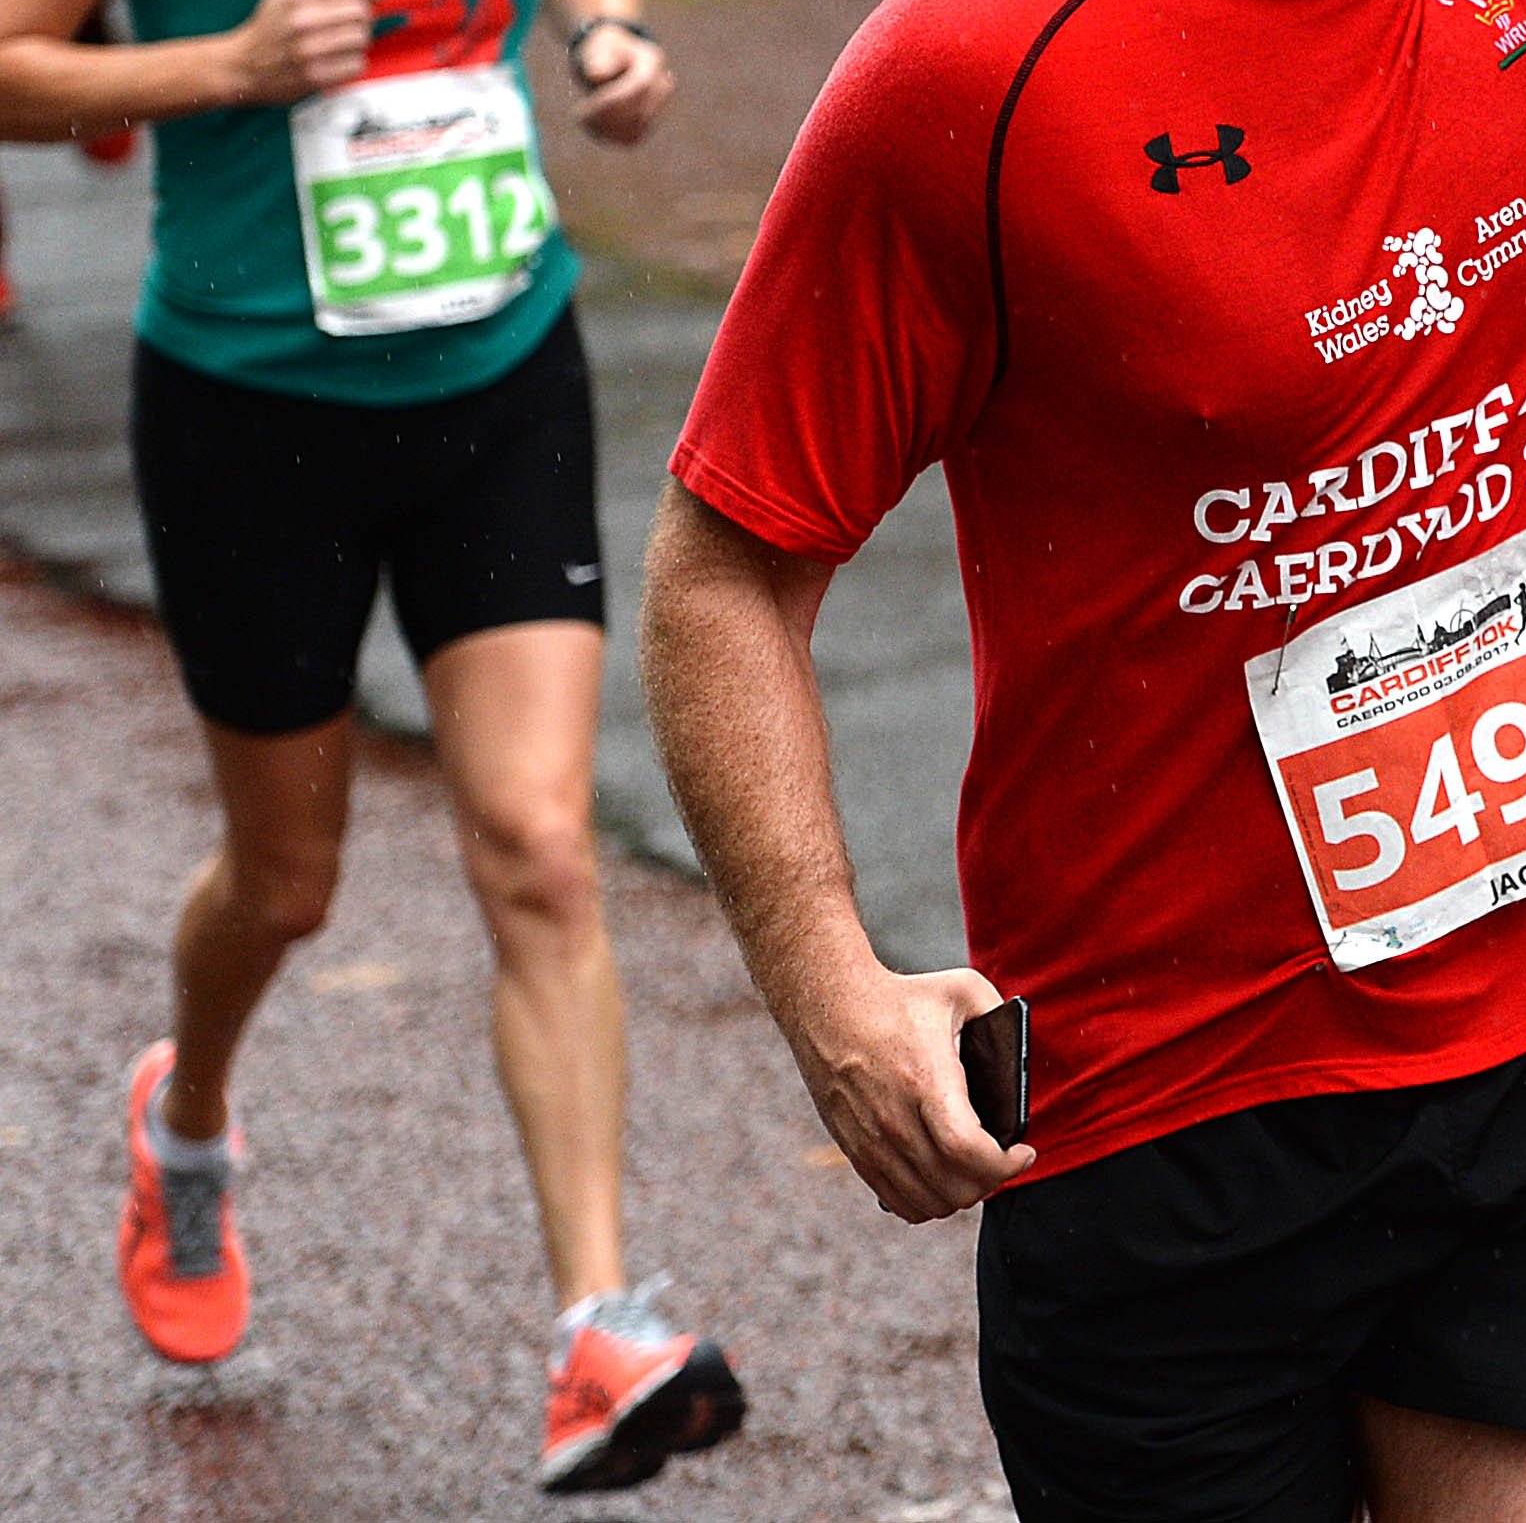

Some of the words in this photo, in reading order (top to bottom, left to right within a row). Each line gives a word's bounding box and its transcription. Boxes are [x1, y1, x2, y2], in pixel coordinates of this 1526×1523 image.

[322, 170, 540, 287] 3312
[1304, 279, 1393, 336] Kidney
[1313, 315, 1390, 364] Wales
[1193, 383, 1515, 544] CARDIFF
[1178, 463, 1513, 613] CAERDYDD
[1329, 642, 1472, 715] CARDIFF
[1472, 615, 1519, 651] 10K
[1336, 685, 1431, 729] CAERDYDD
